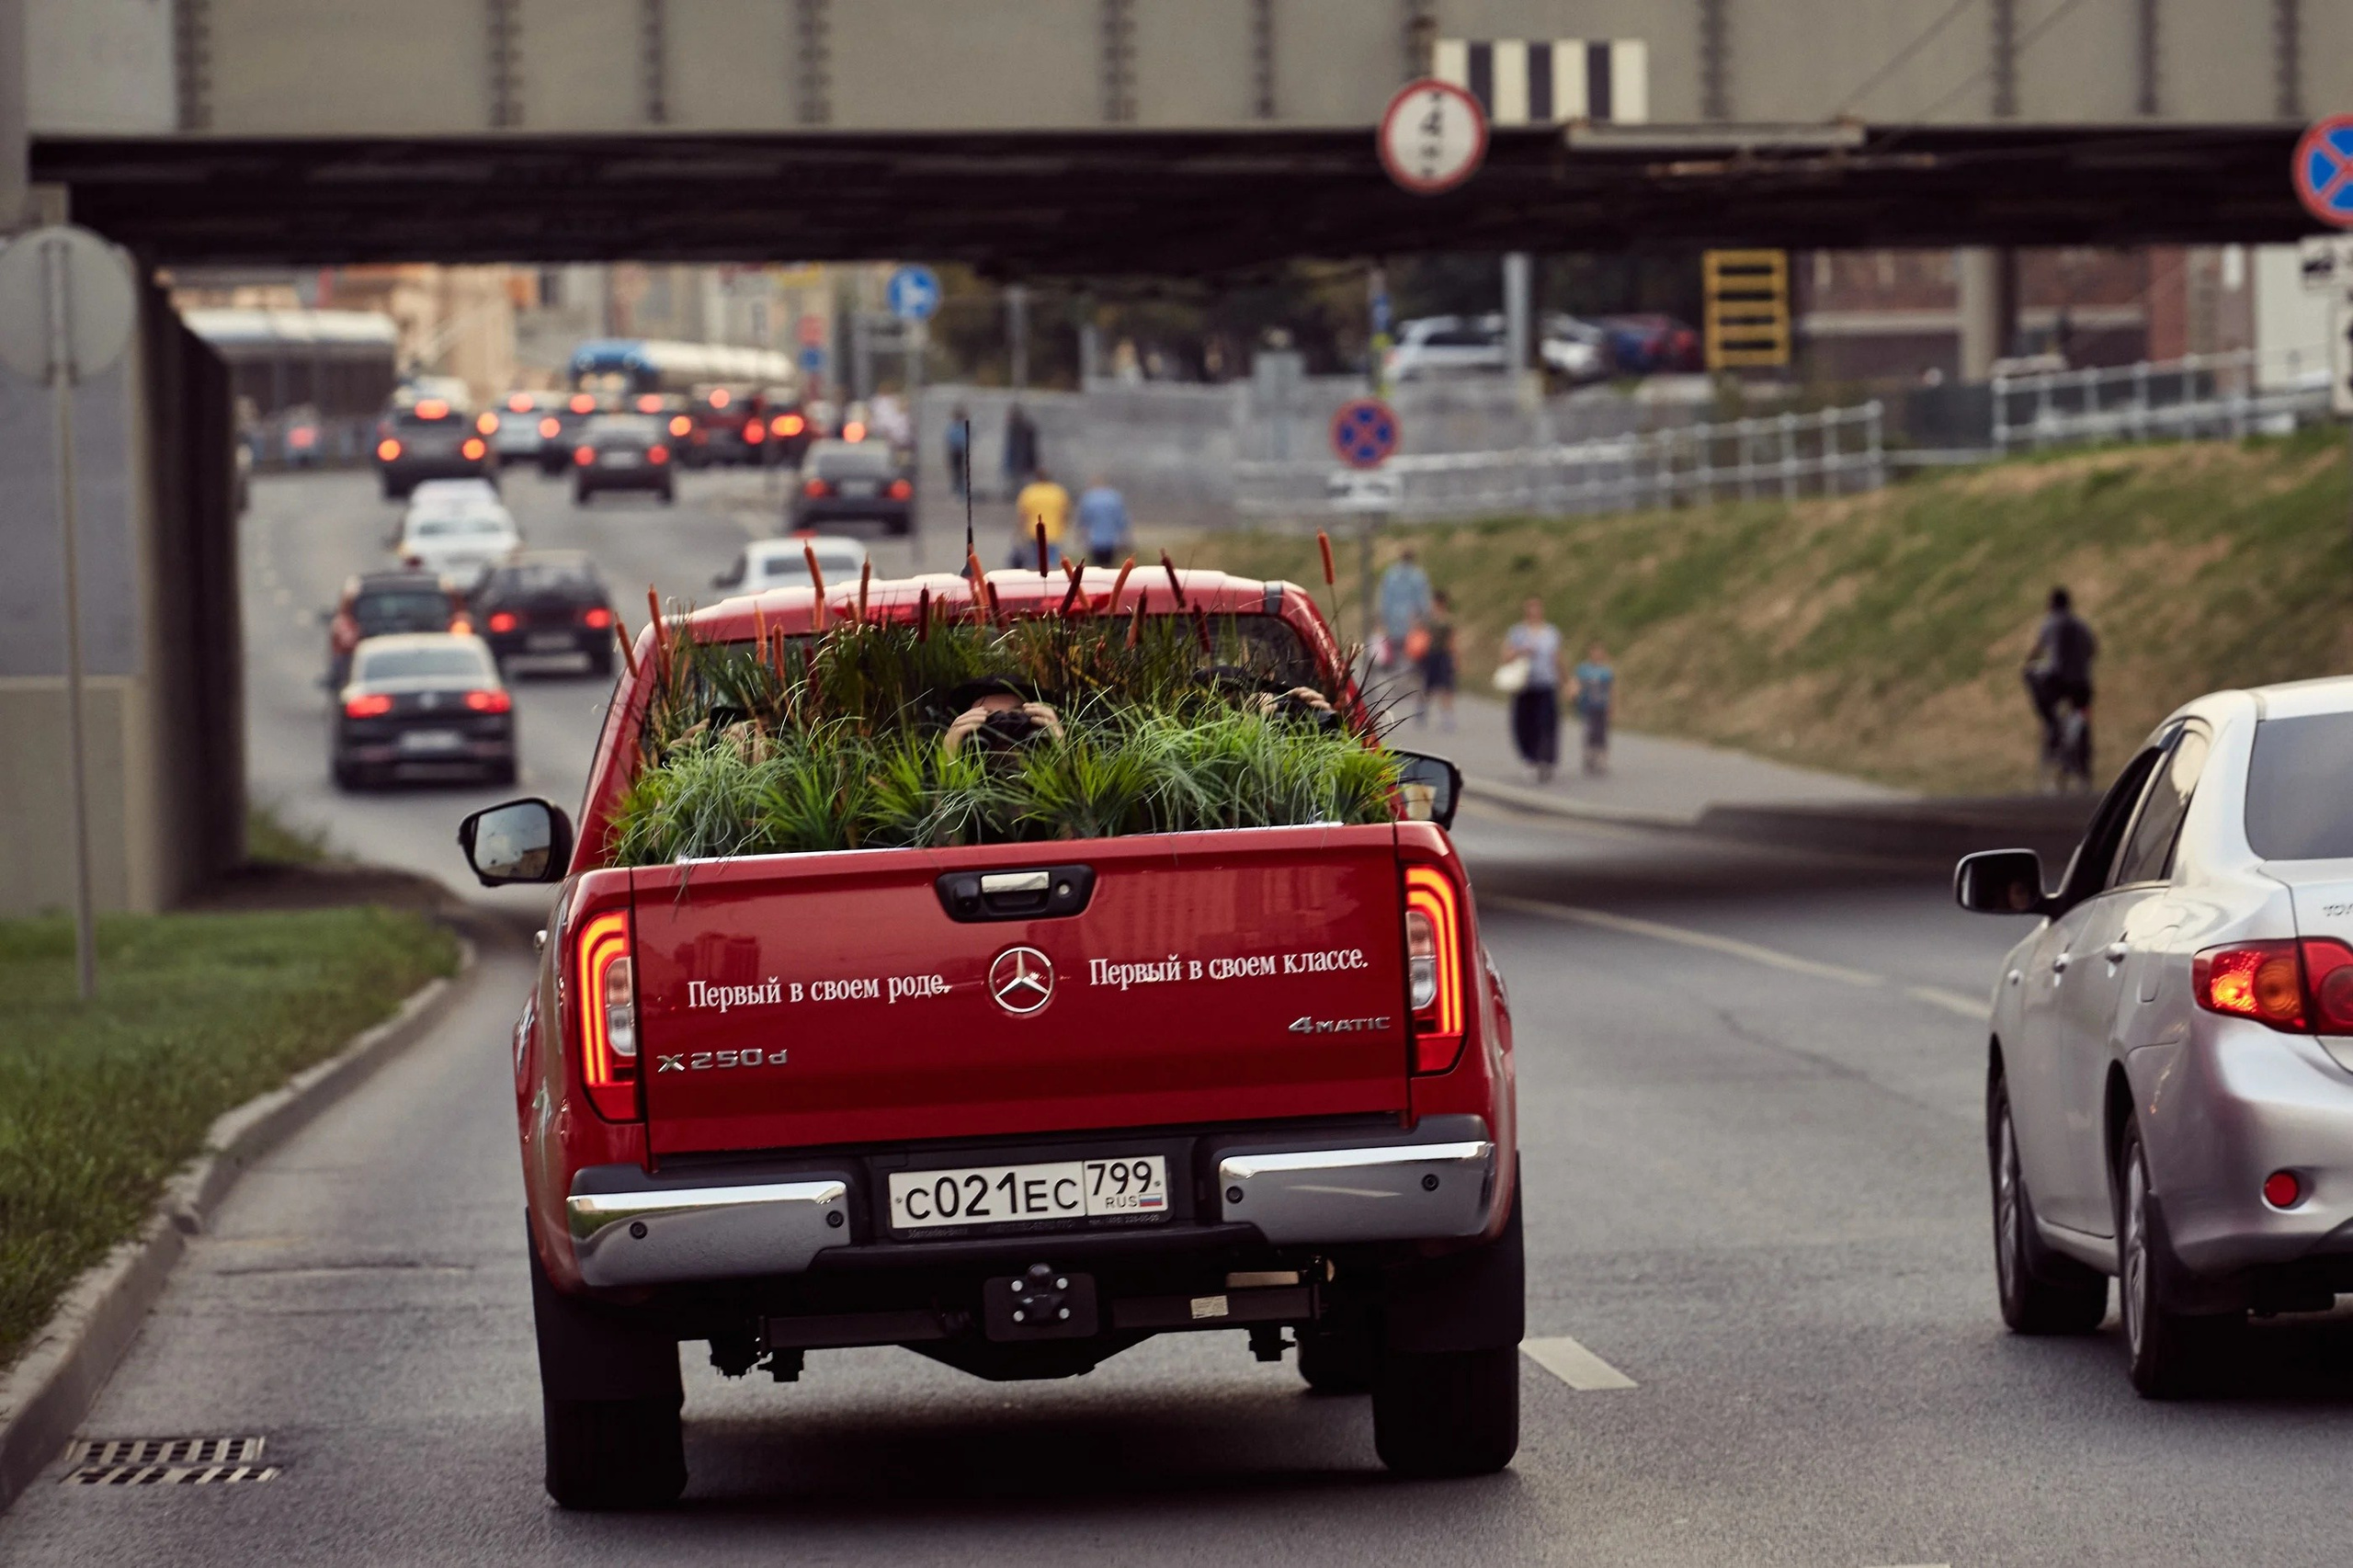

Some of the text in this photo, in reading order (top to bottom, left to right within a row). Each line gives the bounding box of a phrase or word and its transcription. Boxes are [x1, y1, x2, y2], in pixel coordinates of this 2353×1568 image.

[1088, 948, 1370, 992] Первый в своем классе.
[687, 975, 783, 1014] Первый
[789, 982, 803, 1003] в
[810, 977, 881, 1001] своем
[1287, 1016, 1392, 1035] 4MATIC
[1086, 1160, 1154, 1197] 799
[1105, 1194, 1138, 1210] RUS
